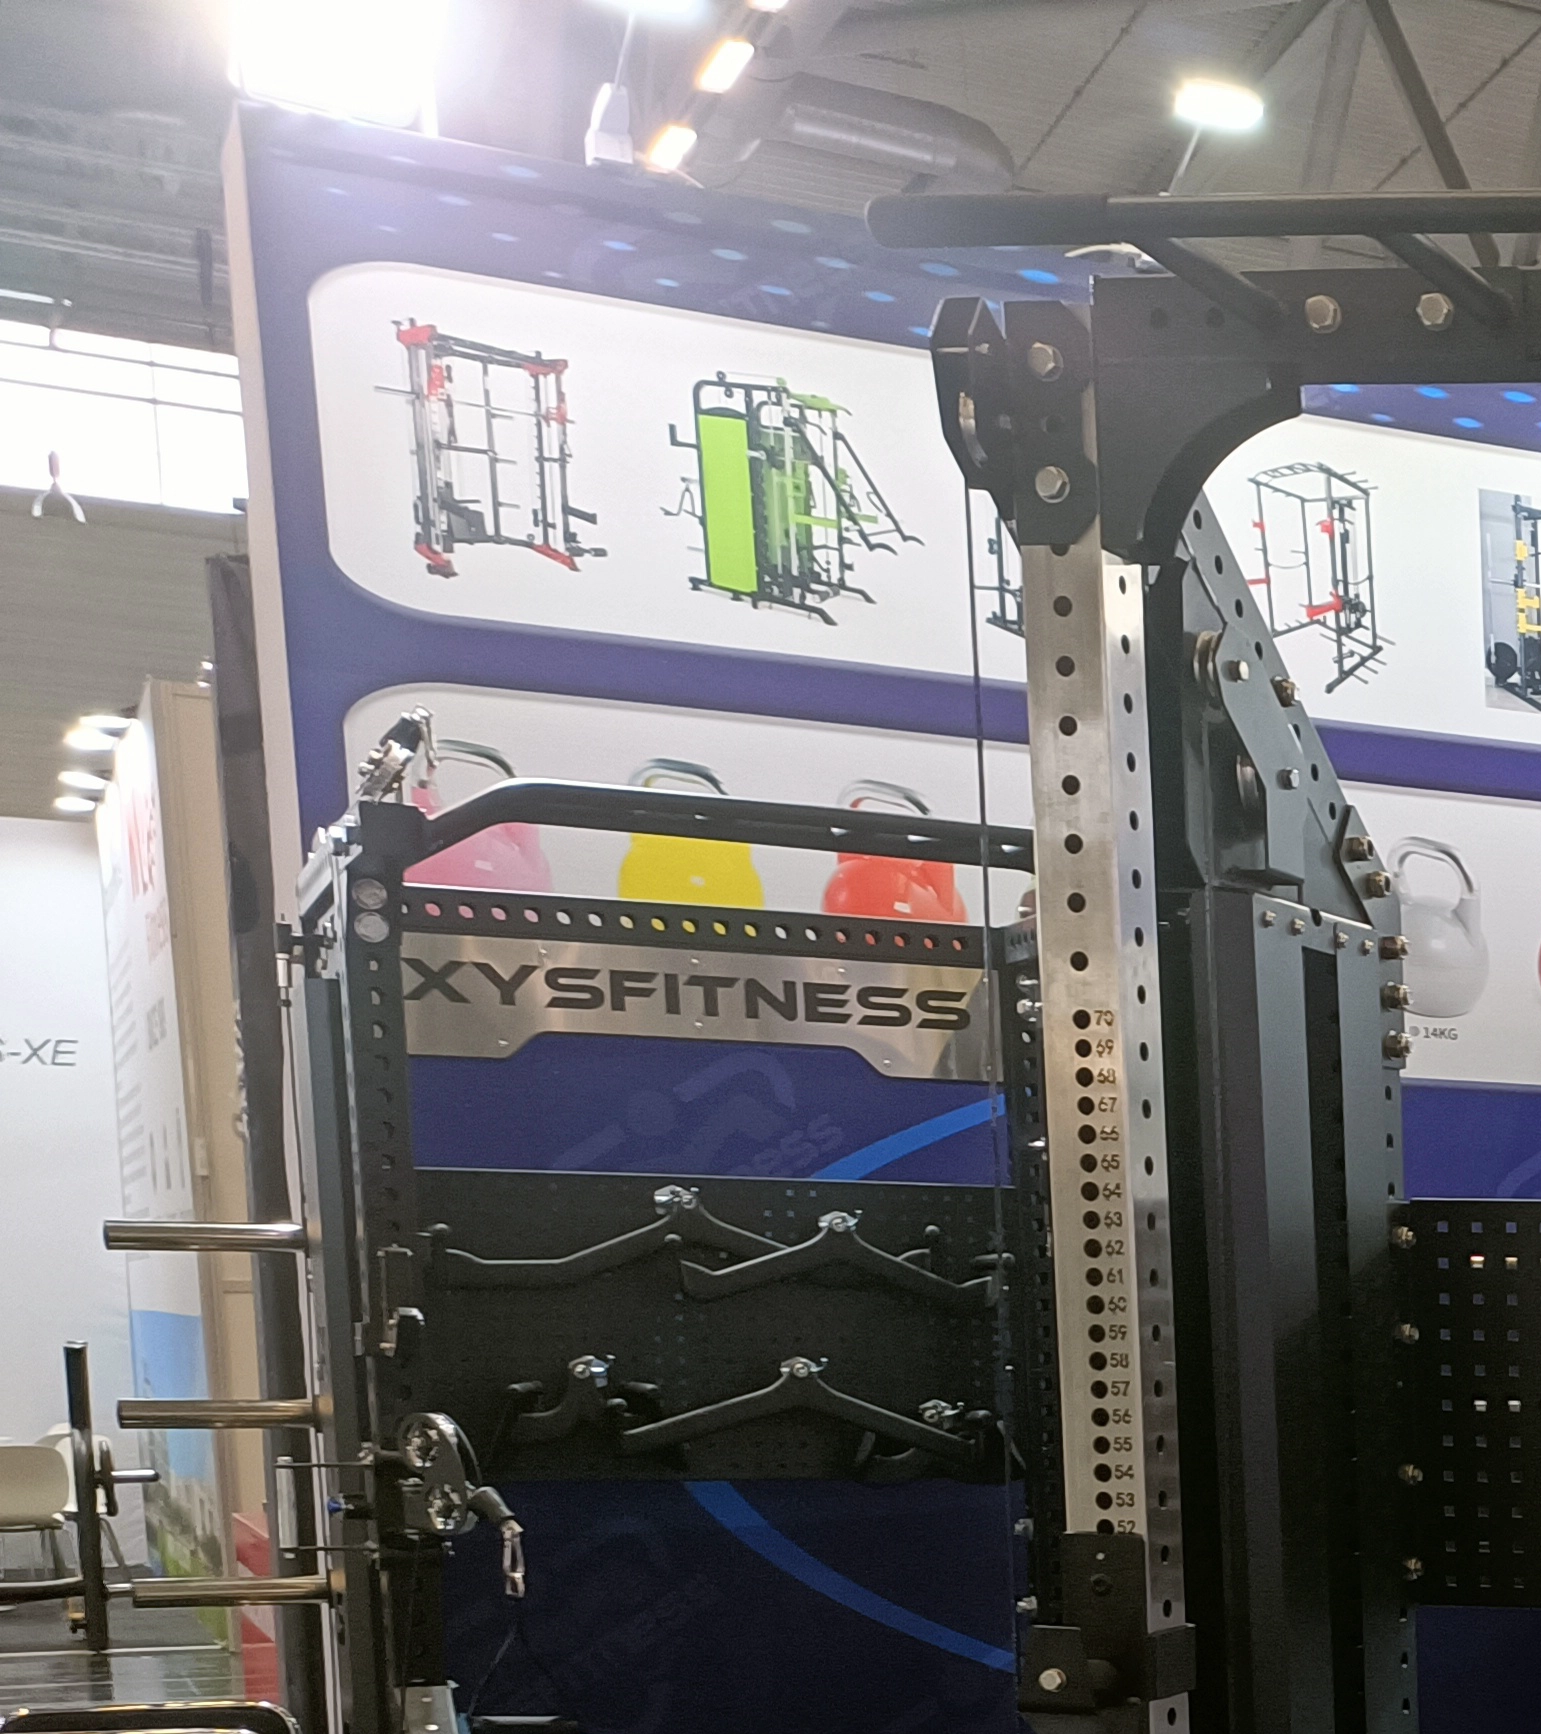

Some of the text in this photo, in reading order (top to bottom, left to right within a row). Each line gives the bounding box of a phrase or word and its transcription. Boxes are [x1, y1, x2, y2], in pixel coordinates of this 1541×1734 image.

[403, 957, 971, 1031] XYSFITNESS
[1094, 1010, 1114, 1026] 70
[1422, 1027, 1459, 1041] 14KG
[0, 1038, 79, 1067] -XE
[1096, 1039, 1114, 1057] 69
[1097, 1069, 1116, 1087] 68
[1098, 1097, 1117, 1113] 67
[1100, 1126, 1119, 1141] 66
[1101, 1154, 1120, 1172] 65
[1102, 1183, 1122, 1201] 64
[1104, 1211, 1122, 1229] 63
[1105, 1240, 1124, 1257] 62
[1107, 1268, 1123, 1284] 61
[1108, 1296, 1126, 1314] 60
[1109, 1325, 1127, 1340] 59
[1110, 1353, 1129, 1368] 58
[1111, 1381, 1130, 1396] 57
[1112, 1409, 1132, 1424] 56
[1113, 1437, 1132, 1452] 55
[1115, 1465, 1134, 1480] 54
[1116, 1492, 1134, 1507] 53
[1117, 1520, 1134, 1533] 52
